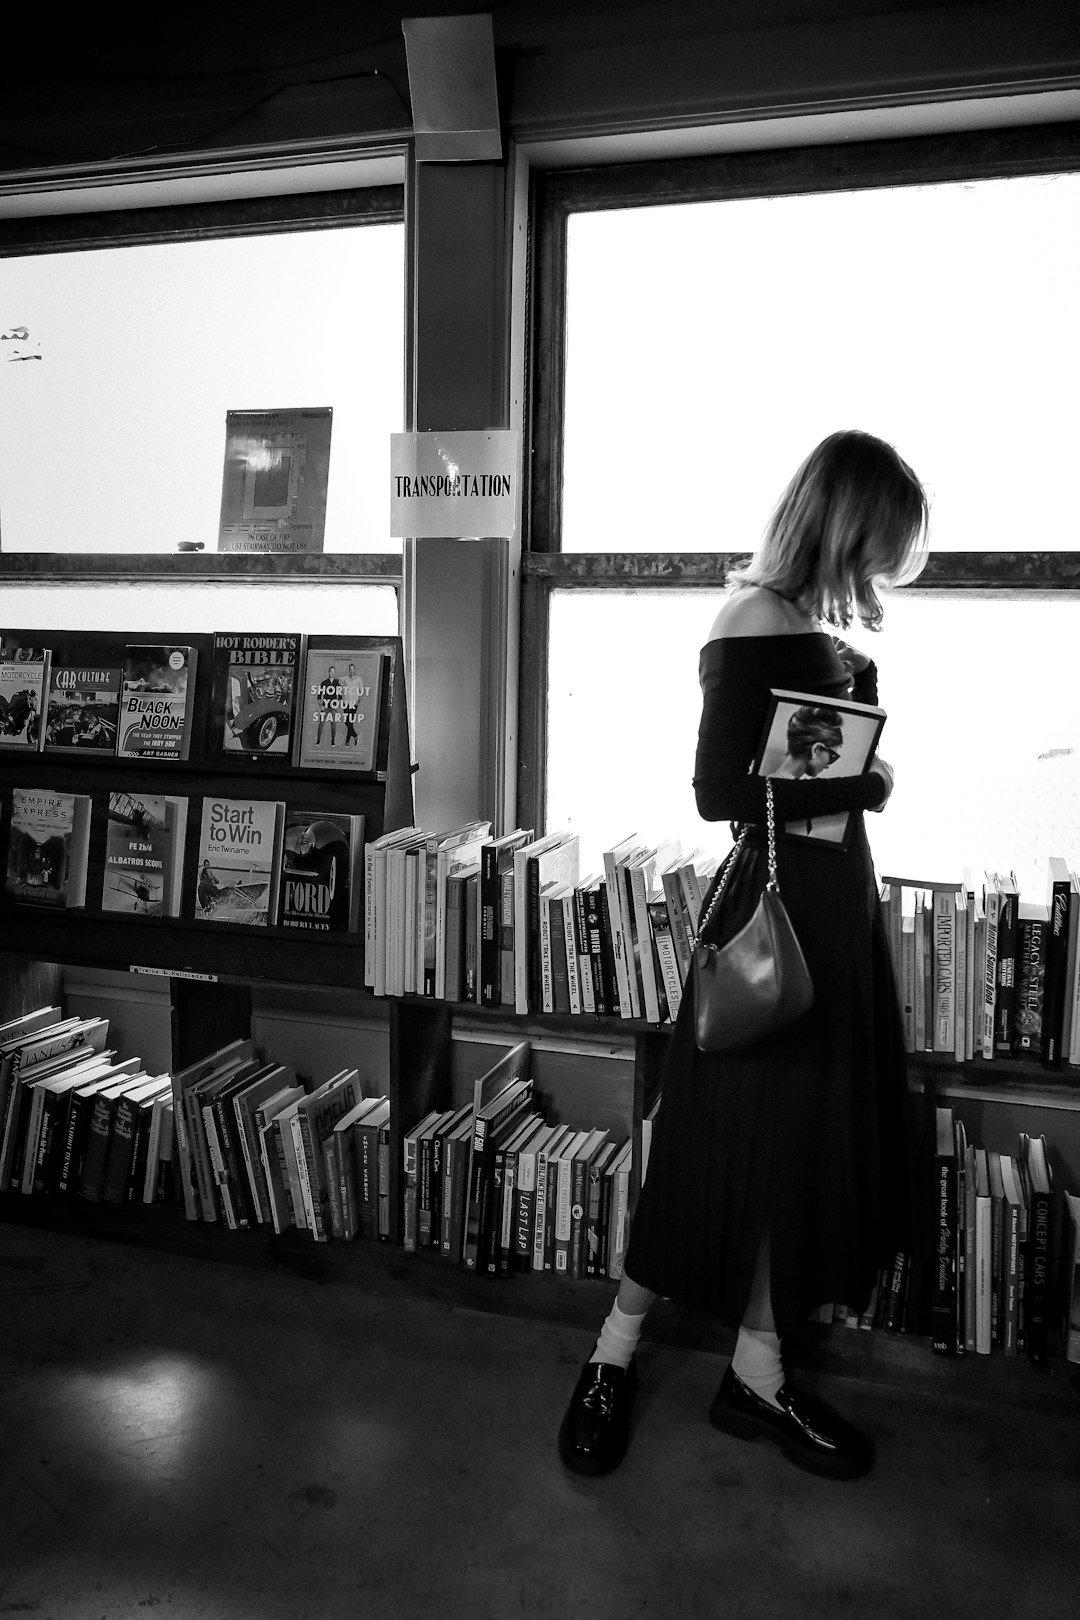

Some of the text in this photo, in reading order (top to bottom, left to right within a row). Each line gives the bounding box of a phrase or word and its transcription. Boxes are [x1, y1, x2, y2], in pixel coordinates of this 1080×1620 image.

[394, 474, 511, 498] TRANSPORTATION
[215, 637, 297, 650] HOT RODDER'S
[228, 650, 296, 666] BIBLE
[55, 670, 111, 689] CAR CULTURE
[310, 685, 372, 697] SHORTCUT
[127, 697, 174, 715] BLACK
[323, 698, 357, 710] YOUR
[312, 712, 365, 723] STARTUP
[15, 806, 68, 819] EXPRESS
[21, 796, 64, 808] EMPIRE
[210, 803, 255, 825] Start
[129, 842, 138, 850] FE
[209, 823, 262, 845] to Win
[207, 844, 220, 853] Eric
[107, 856, 144, 867] ALBATROS
[284, 880, 331, 914] FORD
[1053, 892, 1068, 937] Cadillac
[589, 929, 602, 954] DRIVEN
[674, 920, 684, 940] Bobby
[937, 914, 952, 966] IMPORTED
[987, 921, 998, 955] MotoGP
[1022, 924, 1031, 974] MATTHEW
[1029, 923, 1042, 967] LEGACY
[660, 944, 679, 1000] MOTORCYCLES
[986, 954, 996, 983] Source
[937, 968, 952, 994] CARS
[1027, 976, 1039, 1009] STEEL
[985, 984, 996, 1006] Book
[40, 1111, 50, 1139] American
[221, 1124, 231, 1148] GROUND
[474, 1119, 486, 1152] INDY 500
[61, 1108, 77, 1178] AN EXHIBIT DENIED
[537, 1165, 546, 1203] BLINK EYE
[561, 1163, 569, 1188] TRAGIC
[941, 1166, 949, 1179] the
[444, 1175, 452, 1218] AERODYNAMICS
[939, 1180, 949, 1198] great
[940, 1199, 949, 1218] book
[518, 1195, 531, 1249] LAST LAP
[940, 1218, 949, 1227] of
[1033, 1200, 1049, 1285] CONCEPT CARS
